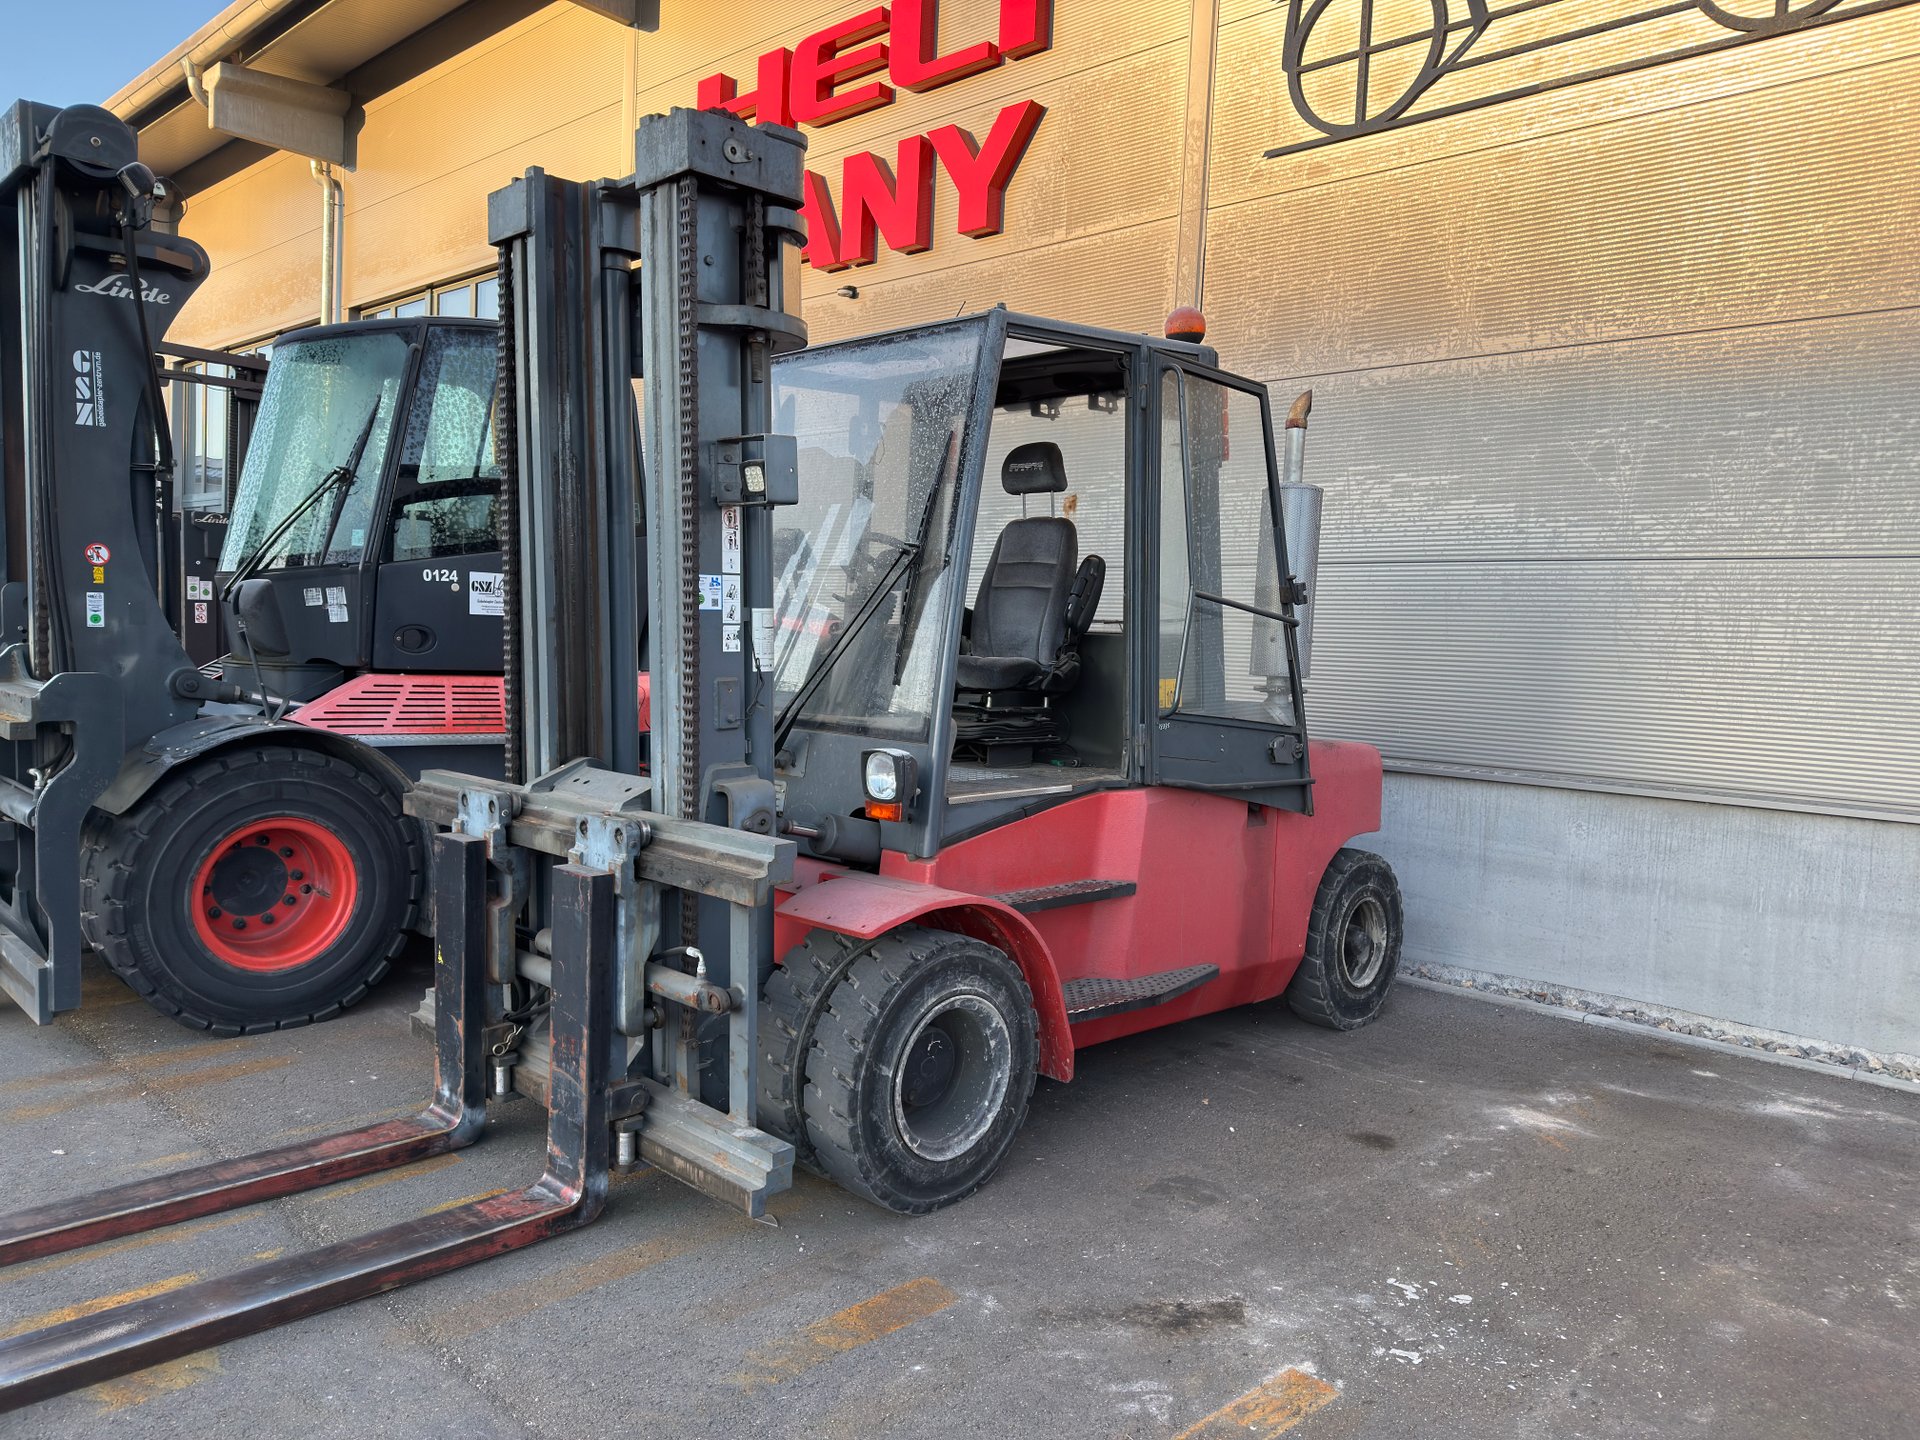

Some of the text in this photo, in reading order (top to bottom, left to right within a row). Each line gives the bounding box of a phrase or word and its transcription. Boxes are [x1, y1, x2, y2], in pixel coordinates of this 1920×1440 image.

[74, 273, 170, 305] Linde
[72, 350, 94, 426] GSZ
[422, 569, 459, 582] 0124
[471, 580, 493, 593] GSZ
